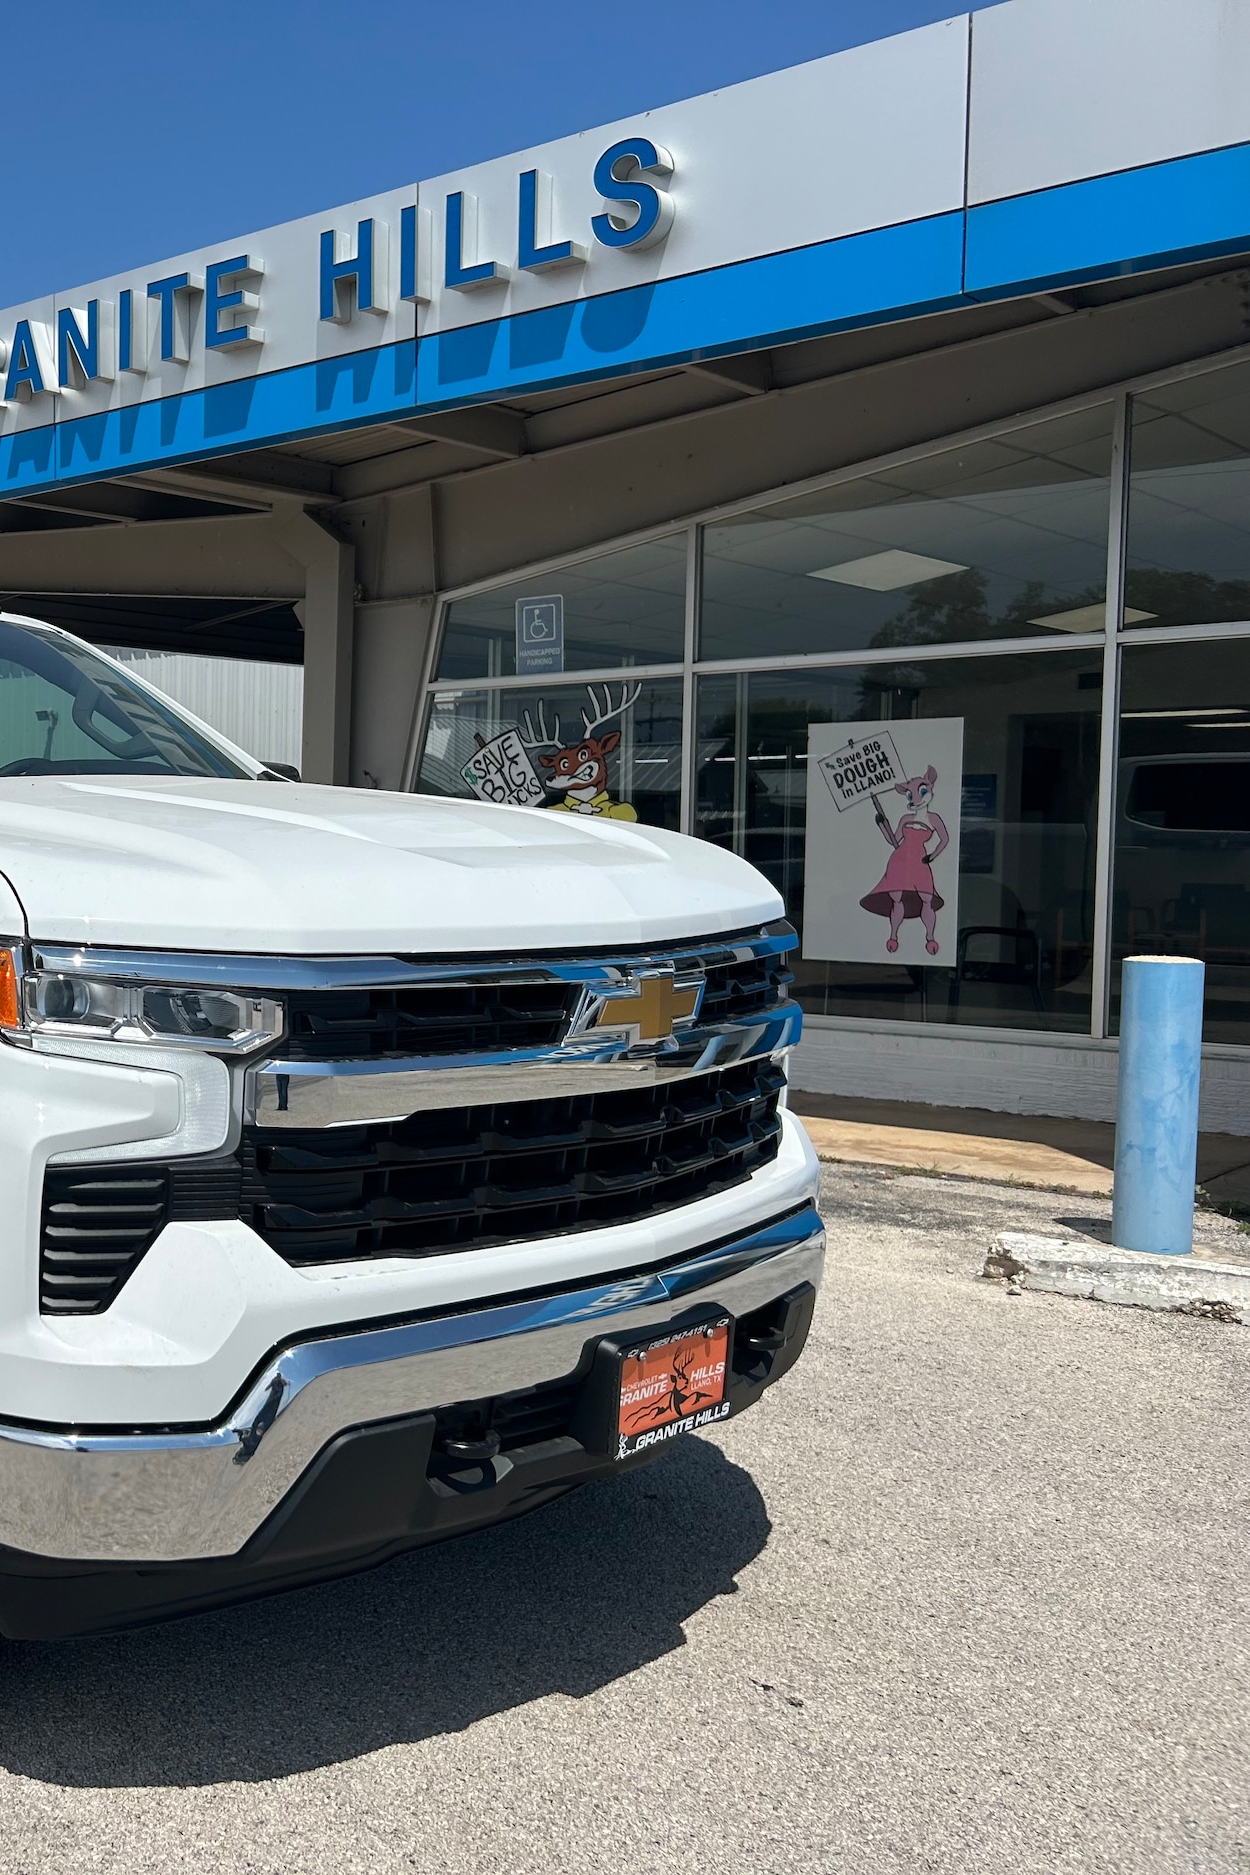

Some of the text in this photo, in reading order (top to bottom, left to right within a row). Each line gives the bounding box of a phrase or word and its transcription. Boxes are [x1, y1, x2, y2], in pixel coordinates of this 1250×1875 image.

[319, 137, 674, 325] HILLS
[518, 647, 561, 658] HANDICAPPED
[526, 657, 553, 667] PARKING
[473, 735, 520, 780] SAVE
[836, 741, 881, 768] Save BIG
[481, 760, 527, 803] BIG
[832, 751, 890, 789] DOUGH
[841, 767, 896, 799] in LLANO!
[626, 1375, 659, 1392] CHEVROLET
[689, 1361, 725, 1383] HILLS
[713, 1374, 722, 1384] TX
[635, 1402, 731, 1450] GRANITE HILLS
